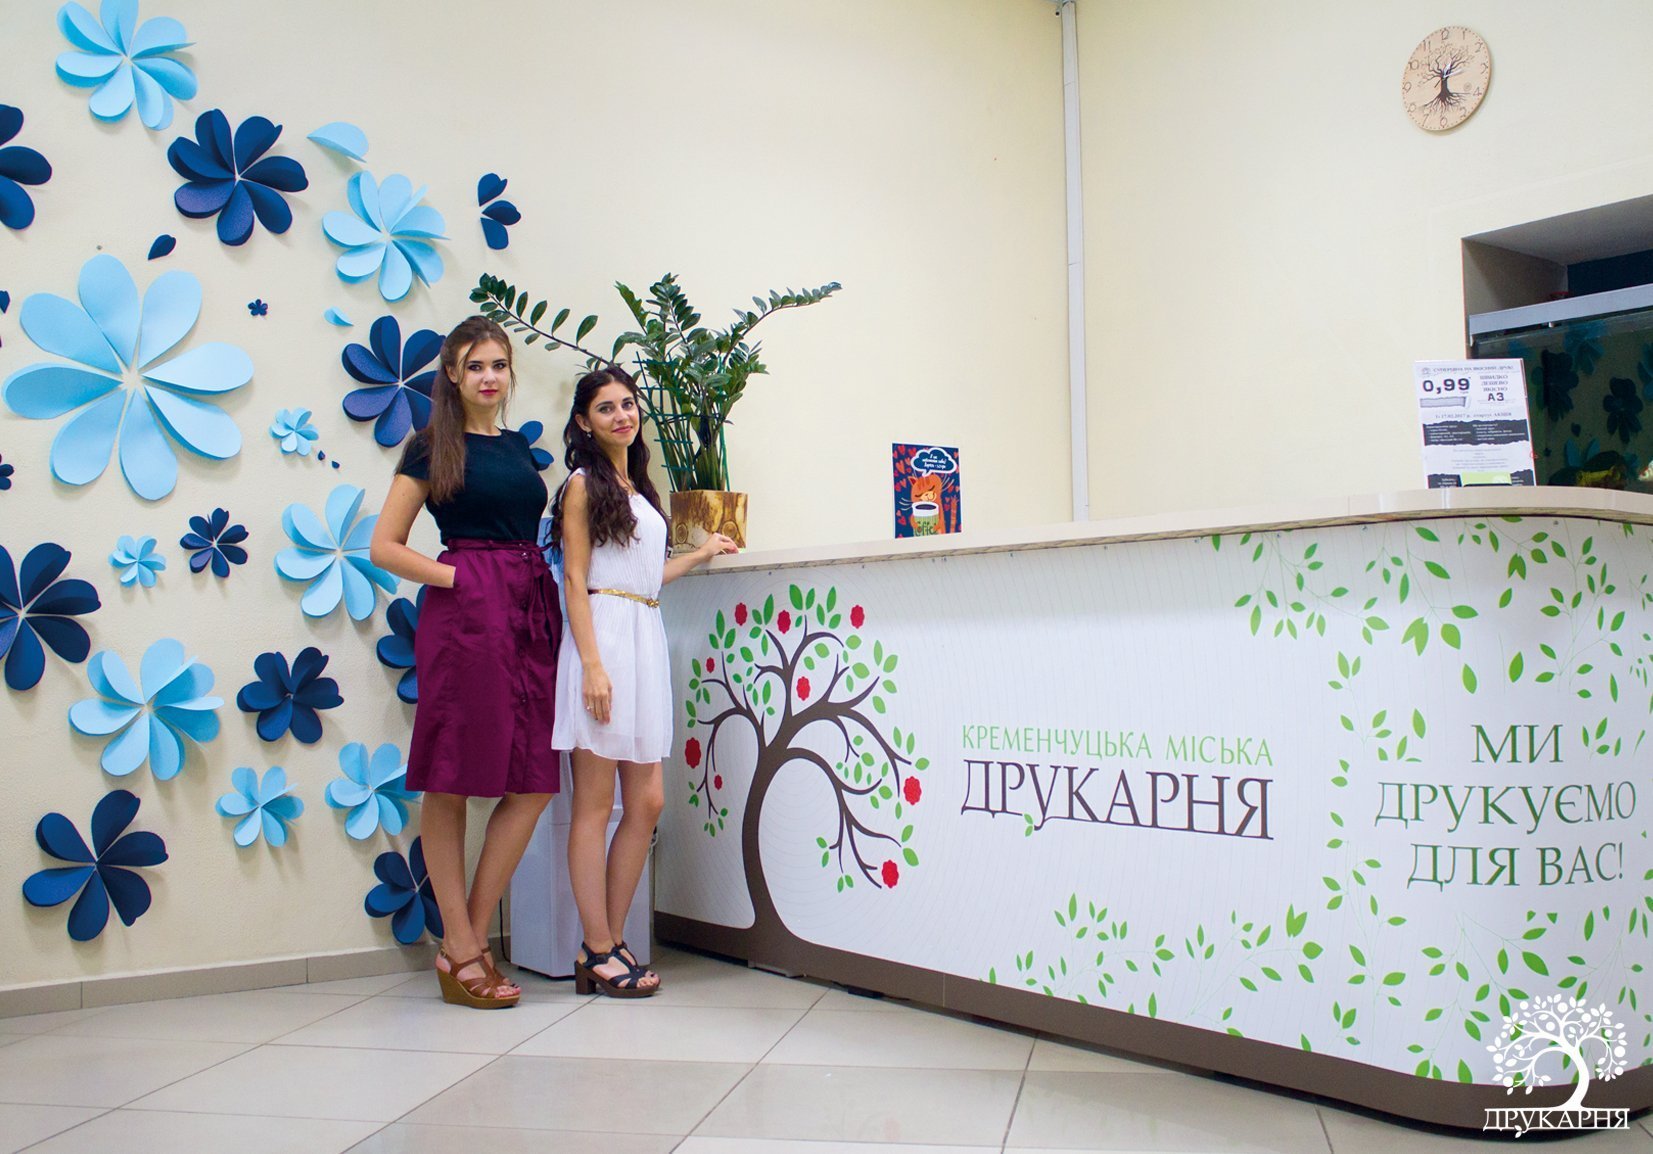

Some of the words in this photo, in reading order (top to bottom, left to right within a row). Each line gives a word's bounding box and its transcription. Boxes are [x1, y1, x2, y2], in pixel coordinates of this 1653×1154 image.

[1473, 86, 1482, 97] 4
[962, 724, 1152, 760] КРЕМЕНЧУЦЬКА
[1165, 734, 1274, 767] МІСЬКА
[1471, 723, 1564, 764] МИ
[960, 759, 1275, 840] ДРУКАРНЯ
[1374, 780, 1637, 835] ДРУКУЄМО
[1406, 842, 1520, 892] ДЛЯ
[1535, 842, 1624, 887] ВАС!
